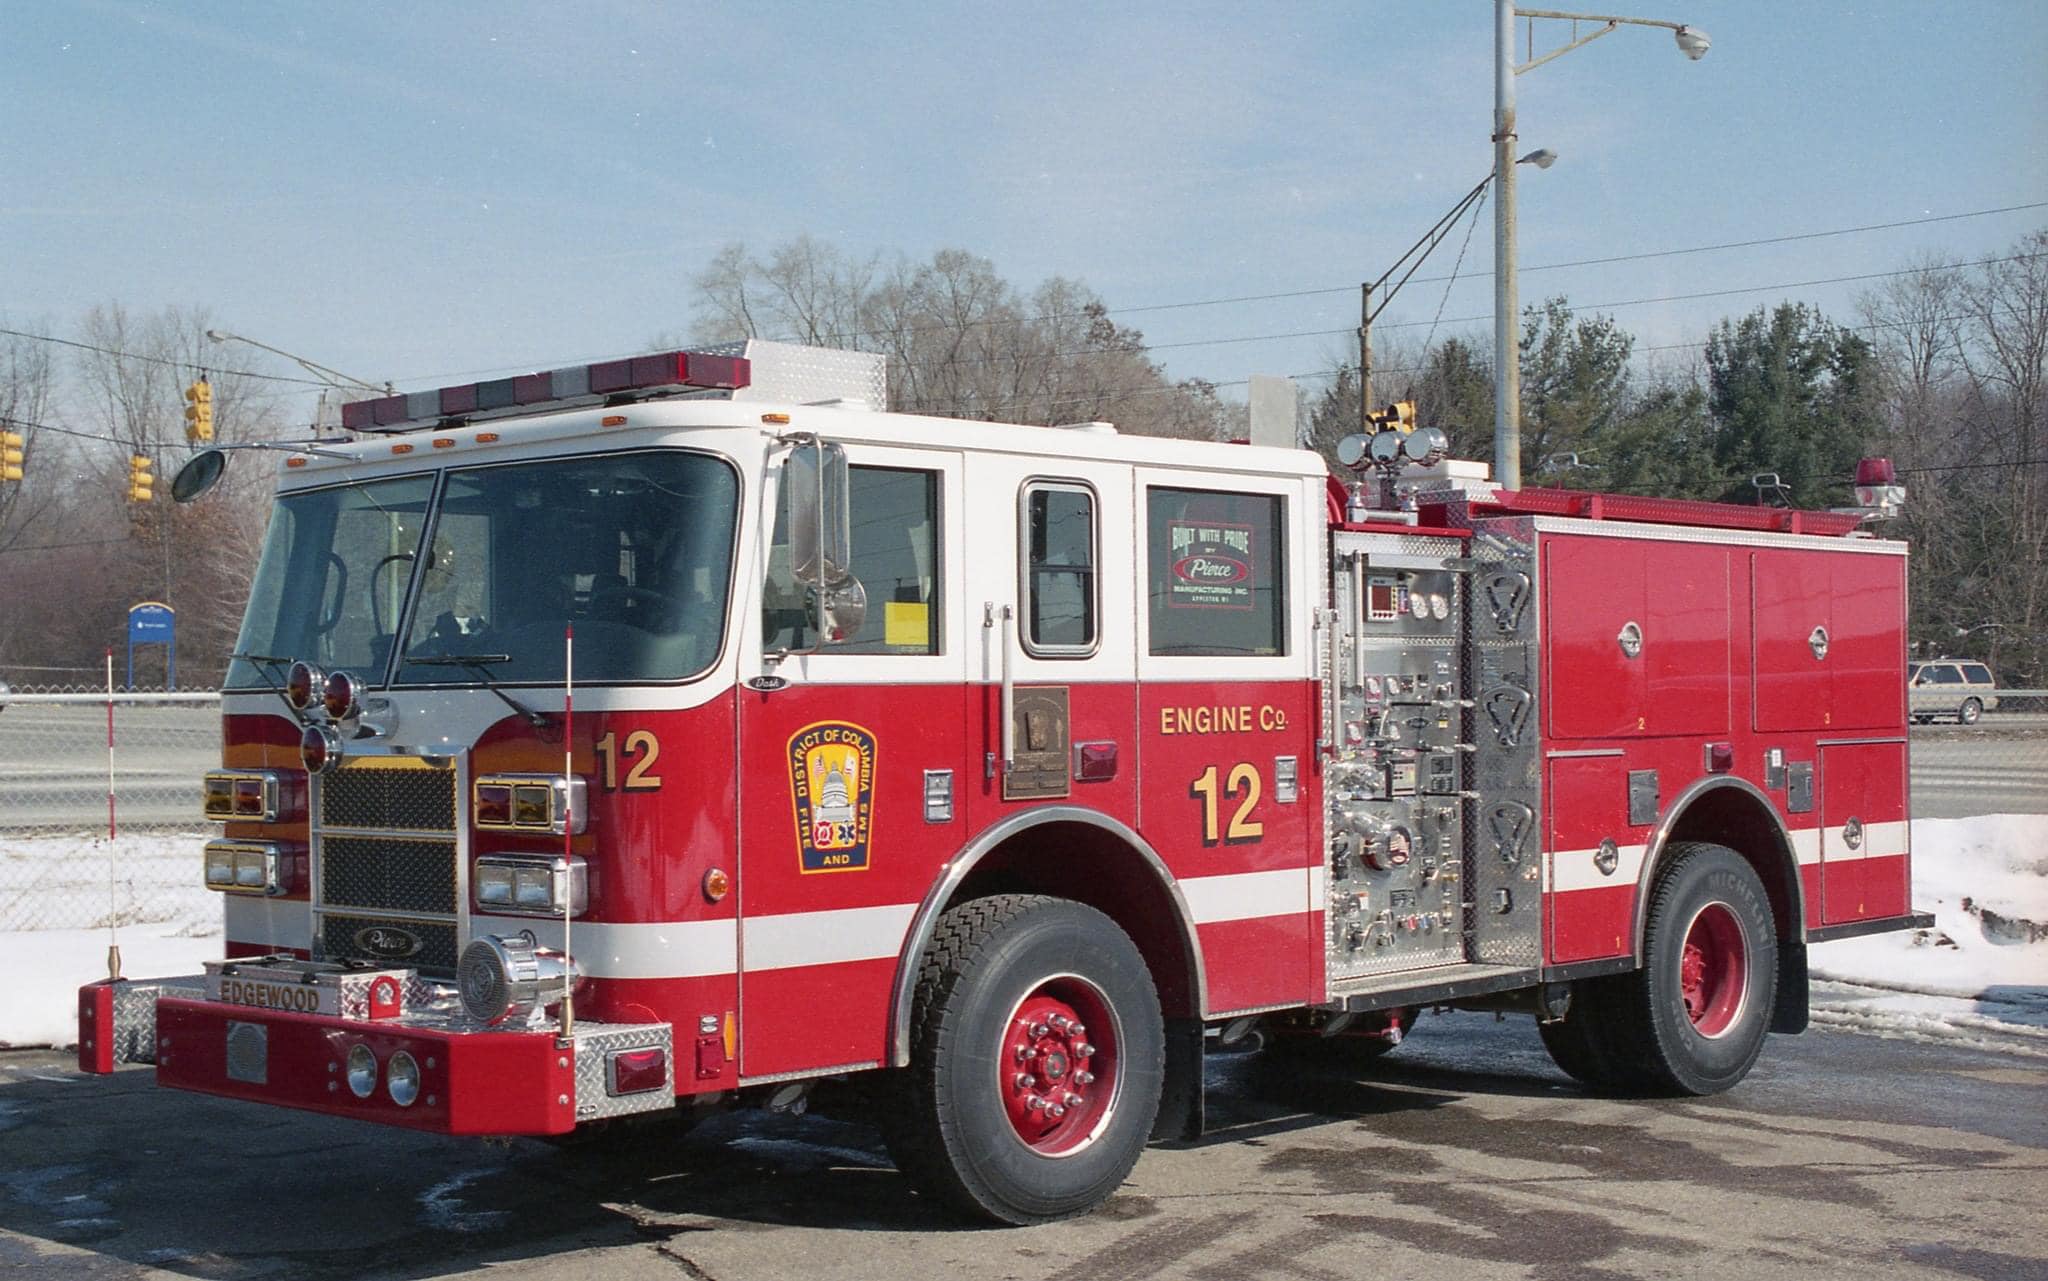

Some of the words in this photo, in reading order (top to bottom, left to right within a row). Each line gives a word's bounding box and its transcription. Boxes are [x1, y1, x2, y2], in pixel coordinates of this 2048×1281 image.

[1172, 527, 1195, 550] BUILT
[1199, 528, 1220, 542] WITH
[1224, 530, 1249, 554] PRIDE
[1191, 559, 1232, 578] Pierce
[1173, 585, 1232, 594] MANUFACTURING
[756, 677, 780, 687] Dash
[1161, 706, 1252, 734] ENGINE
[1638, 717, 1645, 730] 2
[596, 730, 661, 789] 12
[794, 731, 820, 797] DISTRICT
[823, 729, 841, 742] OF
[841, 730, 871, 792] COLUMBIA
[1192, 763, 1264, 842] 12
[799, 807, 812, 849] FIRE
[823, 854, 850, 865] AND
[857, 803, 868, 843] EMS
[1708, 872, 1769, 943] MICHELIN
[220, 980, 320, 1011] EDGEWOOD
